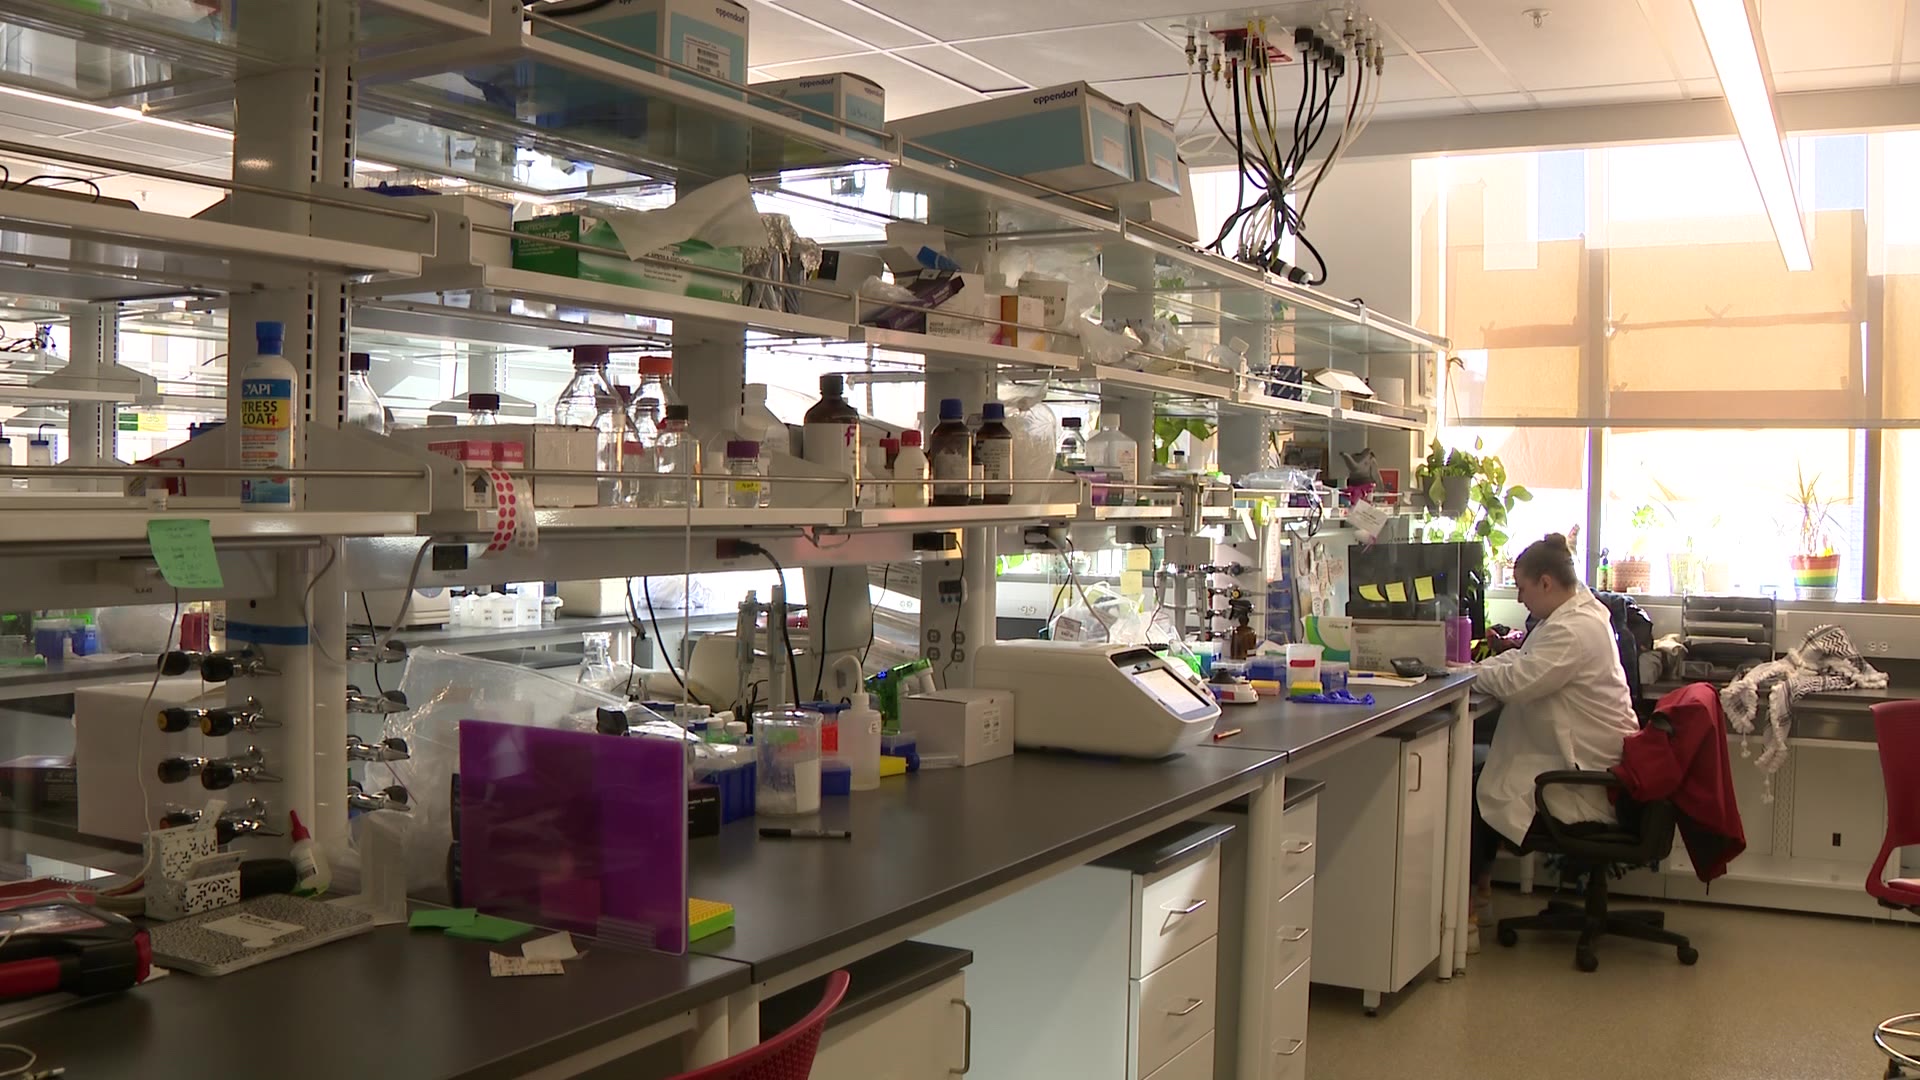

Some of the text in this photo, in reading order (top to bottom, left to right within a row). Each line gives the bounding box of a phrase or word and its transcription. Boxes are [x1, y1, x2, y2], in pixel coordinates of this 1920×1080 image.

[715, 7, 745, 23] eppendorf
[799, 78, 834, 88] eppendorf
[1033, 88, 1078, 104] eppendorf
[250, 384, 270, 395] API
